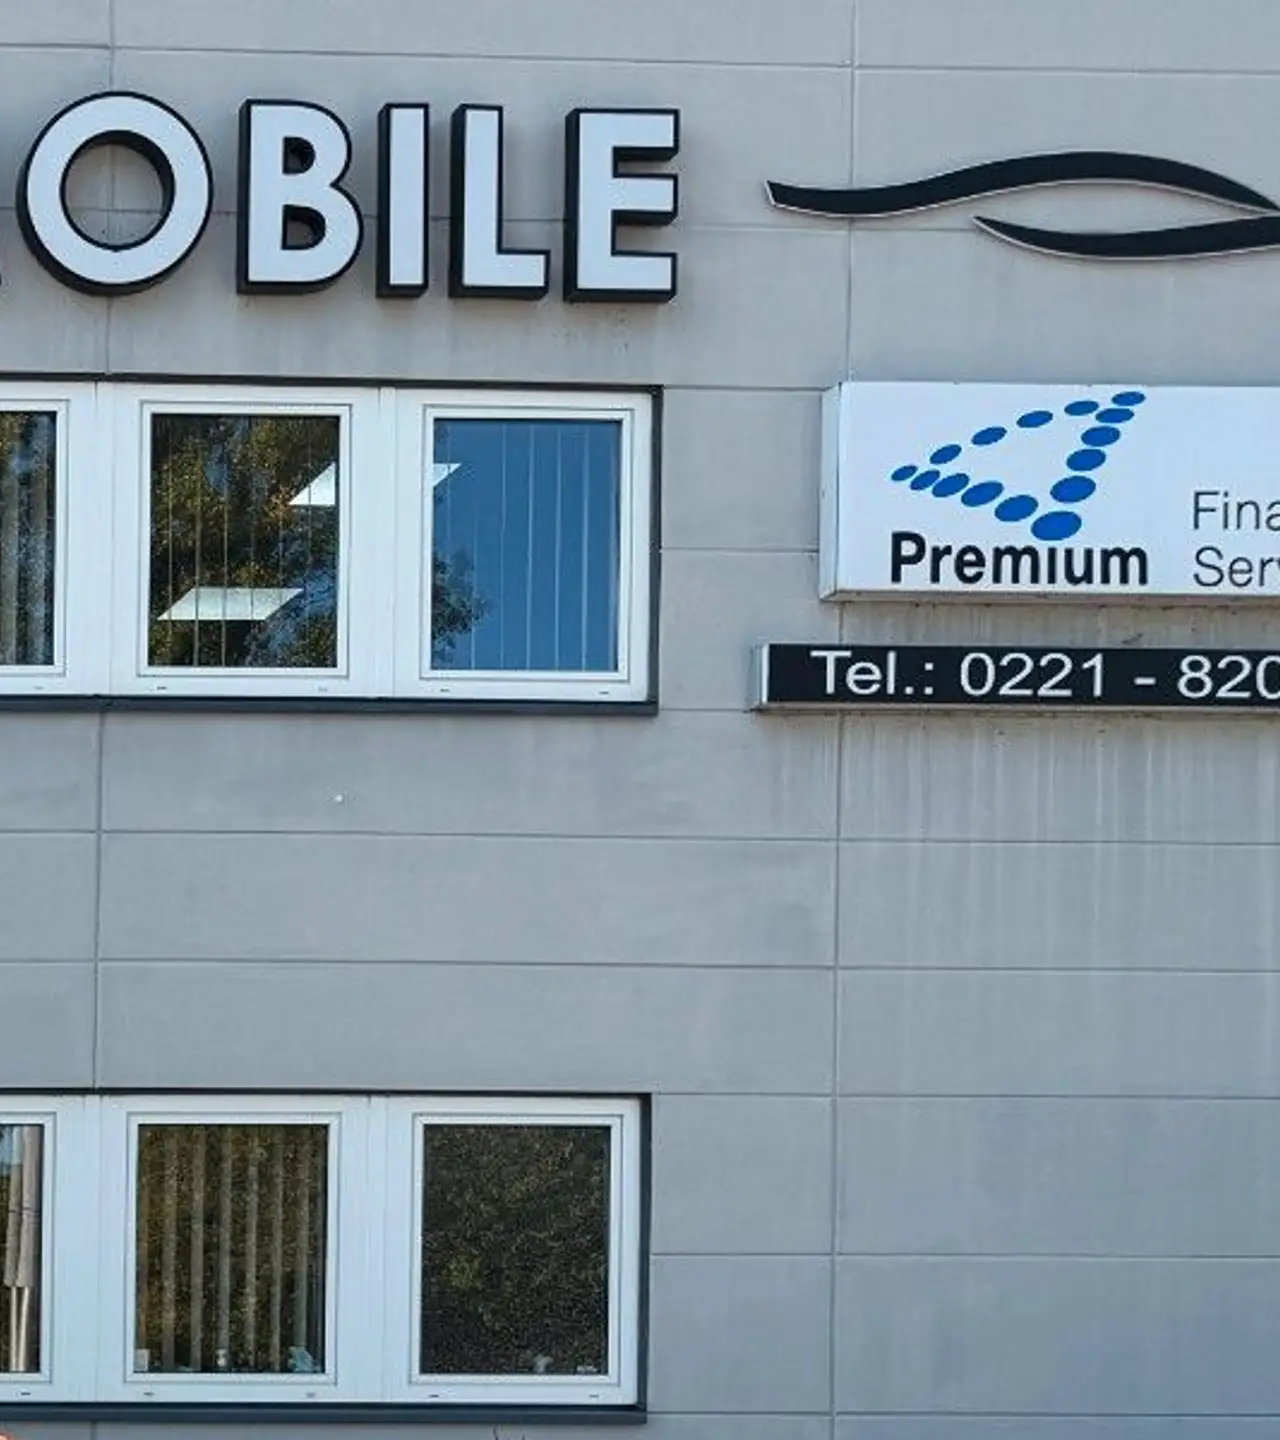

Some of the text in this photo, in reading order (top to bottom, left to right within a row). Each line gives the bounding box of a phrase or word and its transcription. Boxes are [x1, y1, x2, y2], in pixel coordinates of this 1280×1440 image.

[891, 531, 1148, 585] Premium
[1193, 546, 1280, 587] Ser
[811, 650, 934, 696] Tel.:
[960, 652, 1105, 698] 0221
